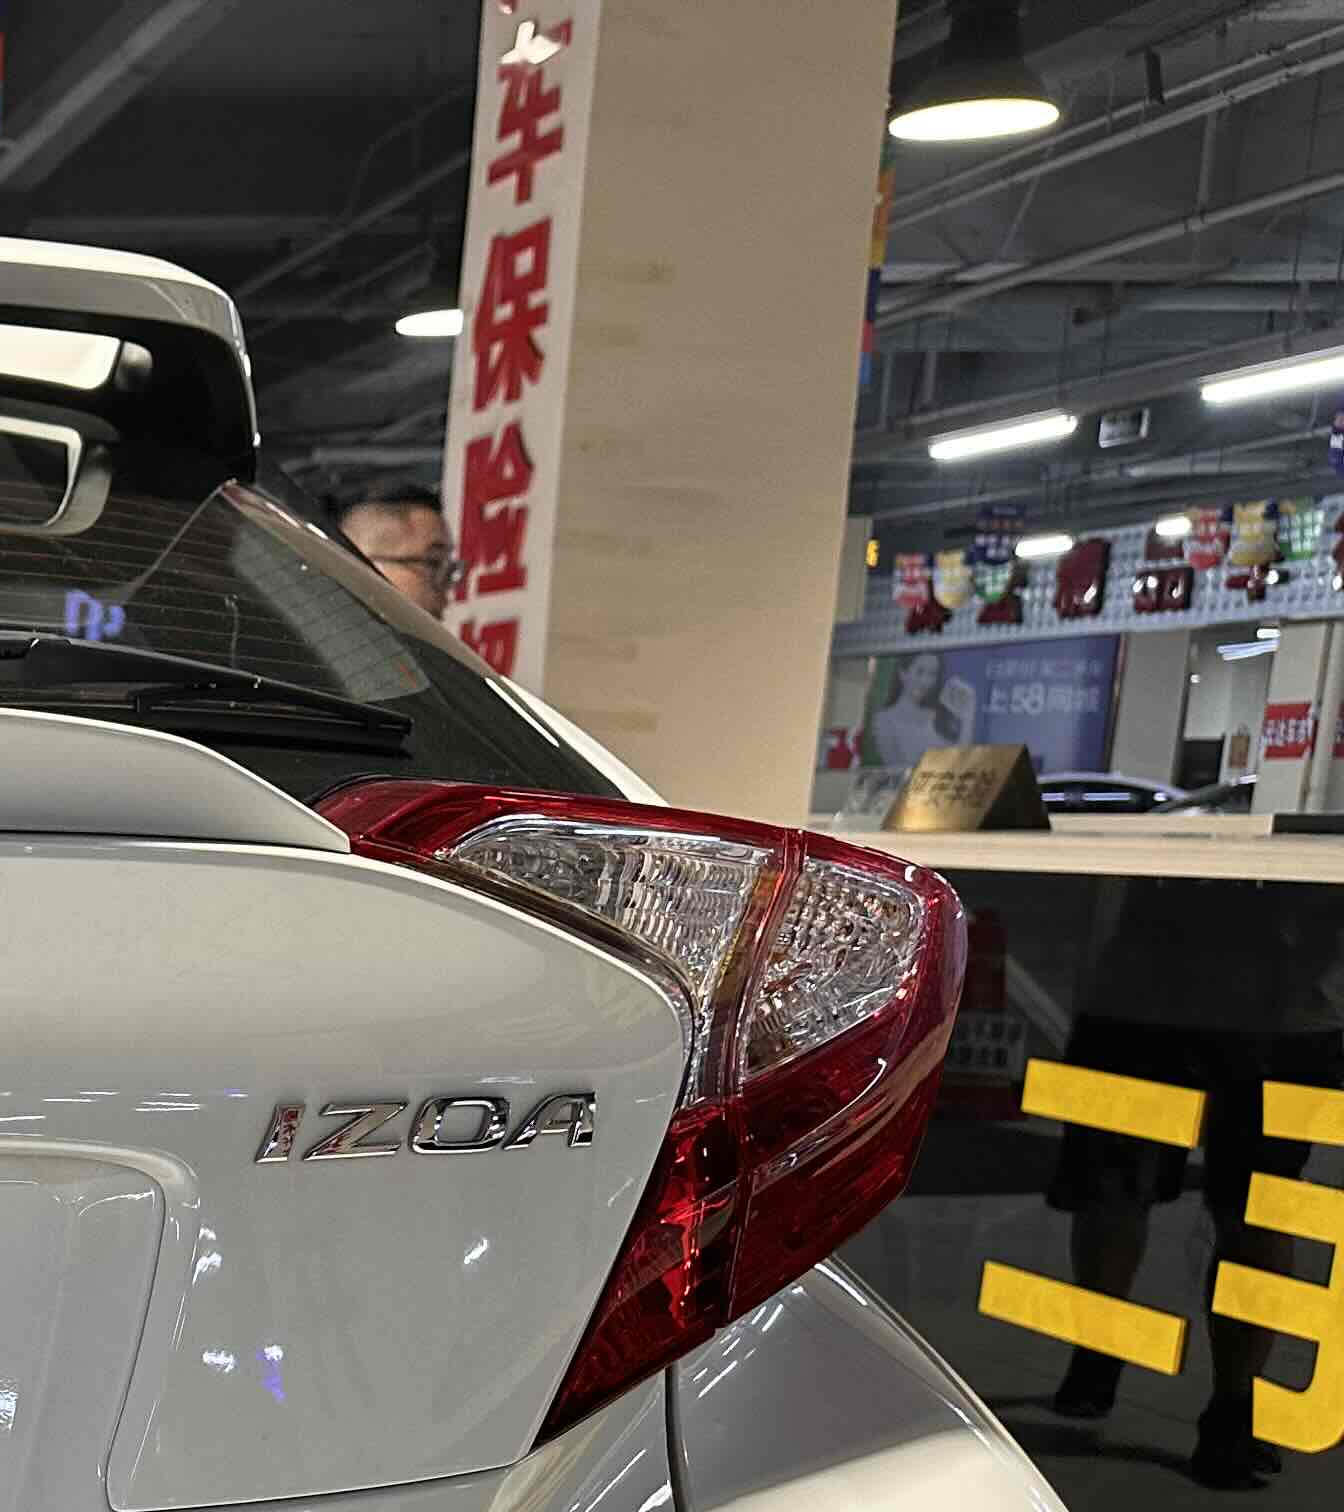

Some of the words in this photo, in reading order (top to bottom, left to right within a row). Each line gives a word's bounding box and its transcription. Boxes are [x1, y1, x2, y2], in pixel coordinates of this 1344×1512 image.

[454, 0, 574, 676] 车保险
[255, 1092, 597, 1163] IZOA
